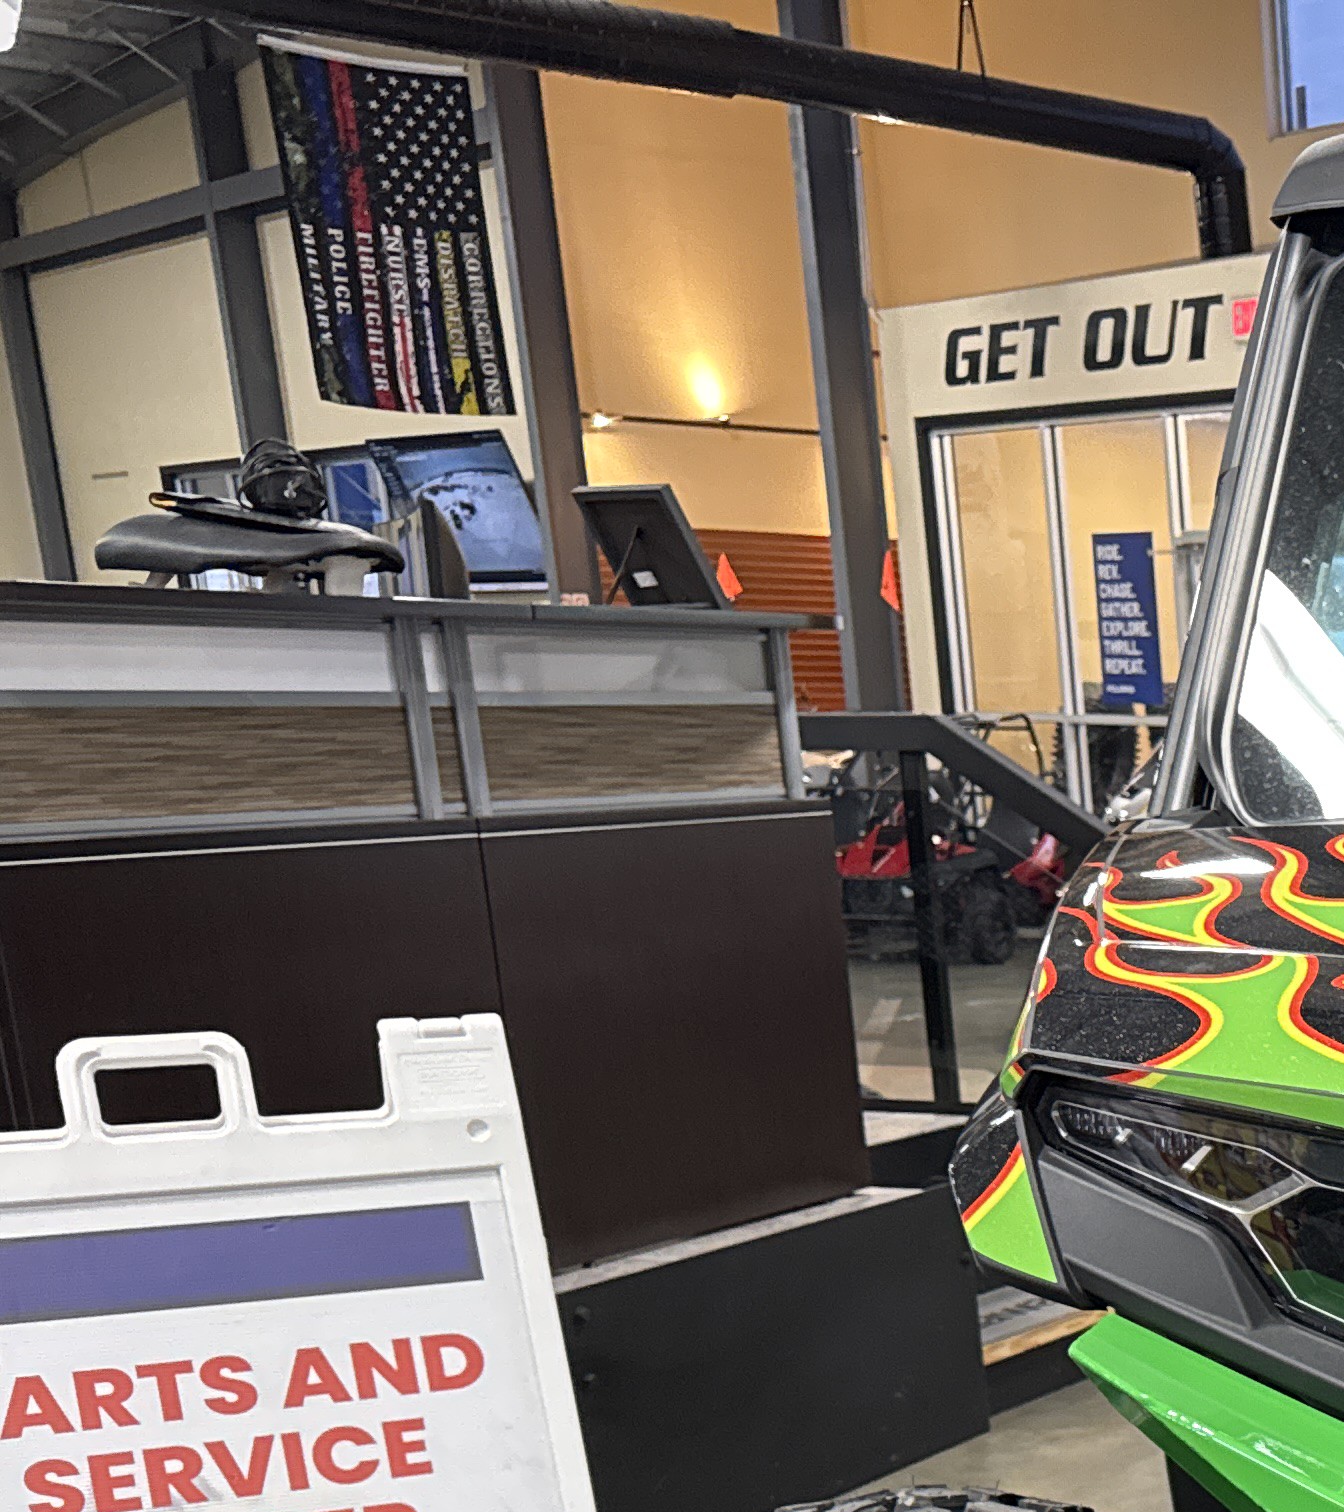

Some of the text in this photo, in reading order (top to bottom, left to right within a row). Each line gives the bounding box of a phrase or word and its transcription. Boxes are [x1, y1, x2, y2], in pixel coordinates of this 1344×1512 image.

[300, 223, 334, 348] MILITARY
[327, 227, 353, 315] POLICE
[355, 231, 390, 391] FIREFIGHTER
[464, 243, 504, 409] CORRECTIONS
[945, 316, 1060, 387] GET
[1084, 294, 1223, 372] OUT
[1099, 581, 1137, 599] CHASE.
[1102, 620, 1152, 637] EXPLORE.
[1103, 639, 1143, 656] THRILL.
[1104, 657, 1147, 675] REPEAT.
[0, 1333, 485, 1440] ARTS AND
